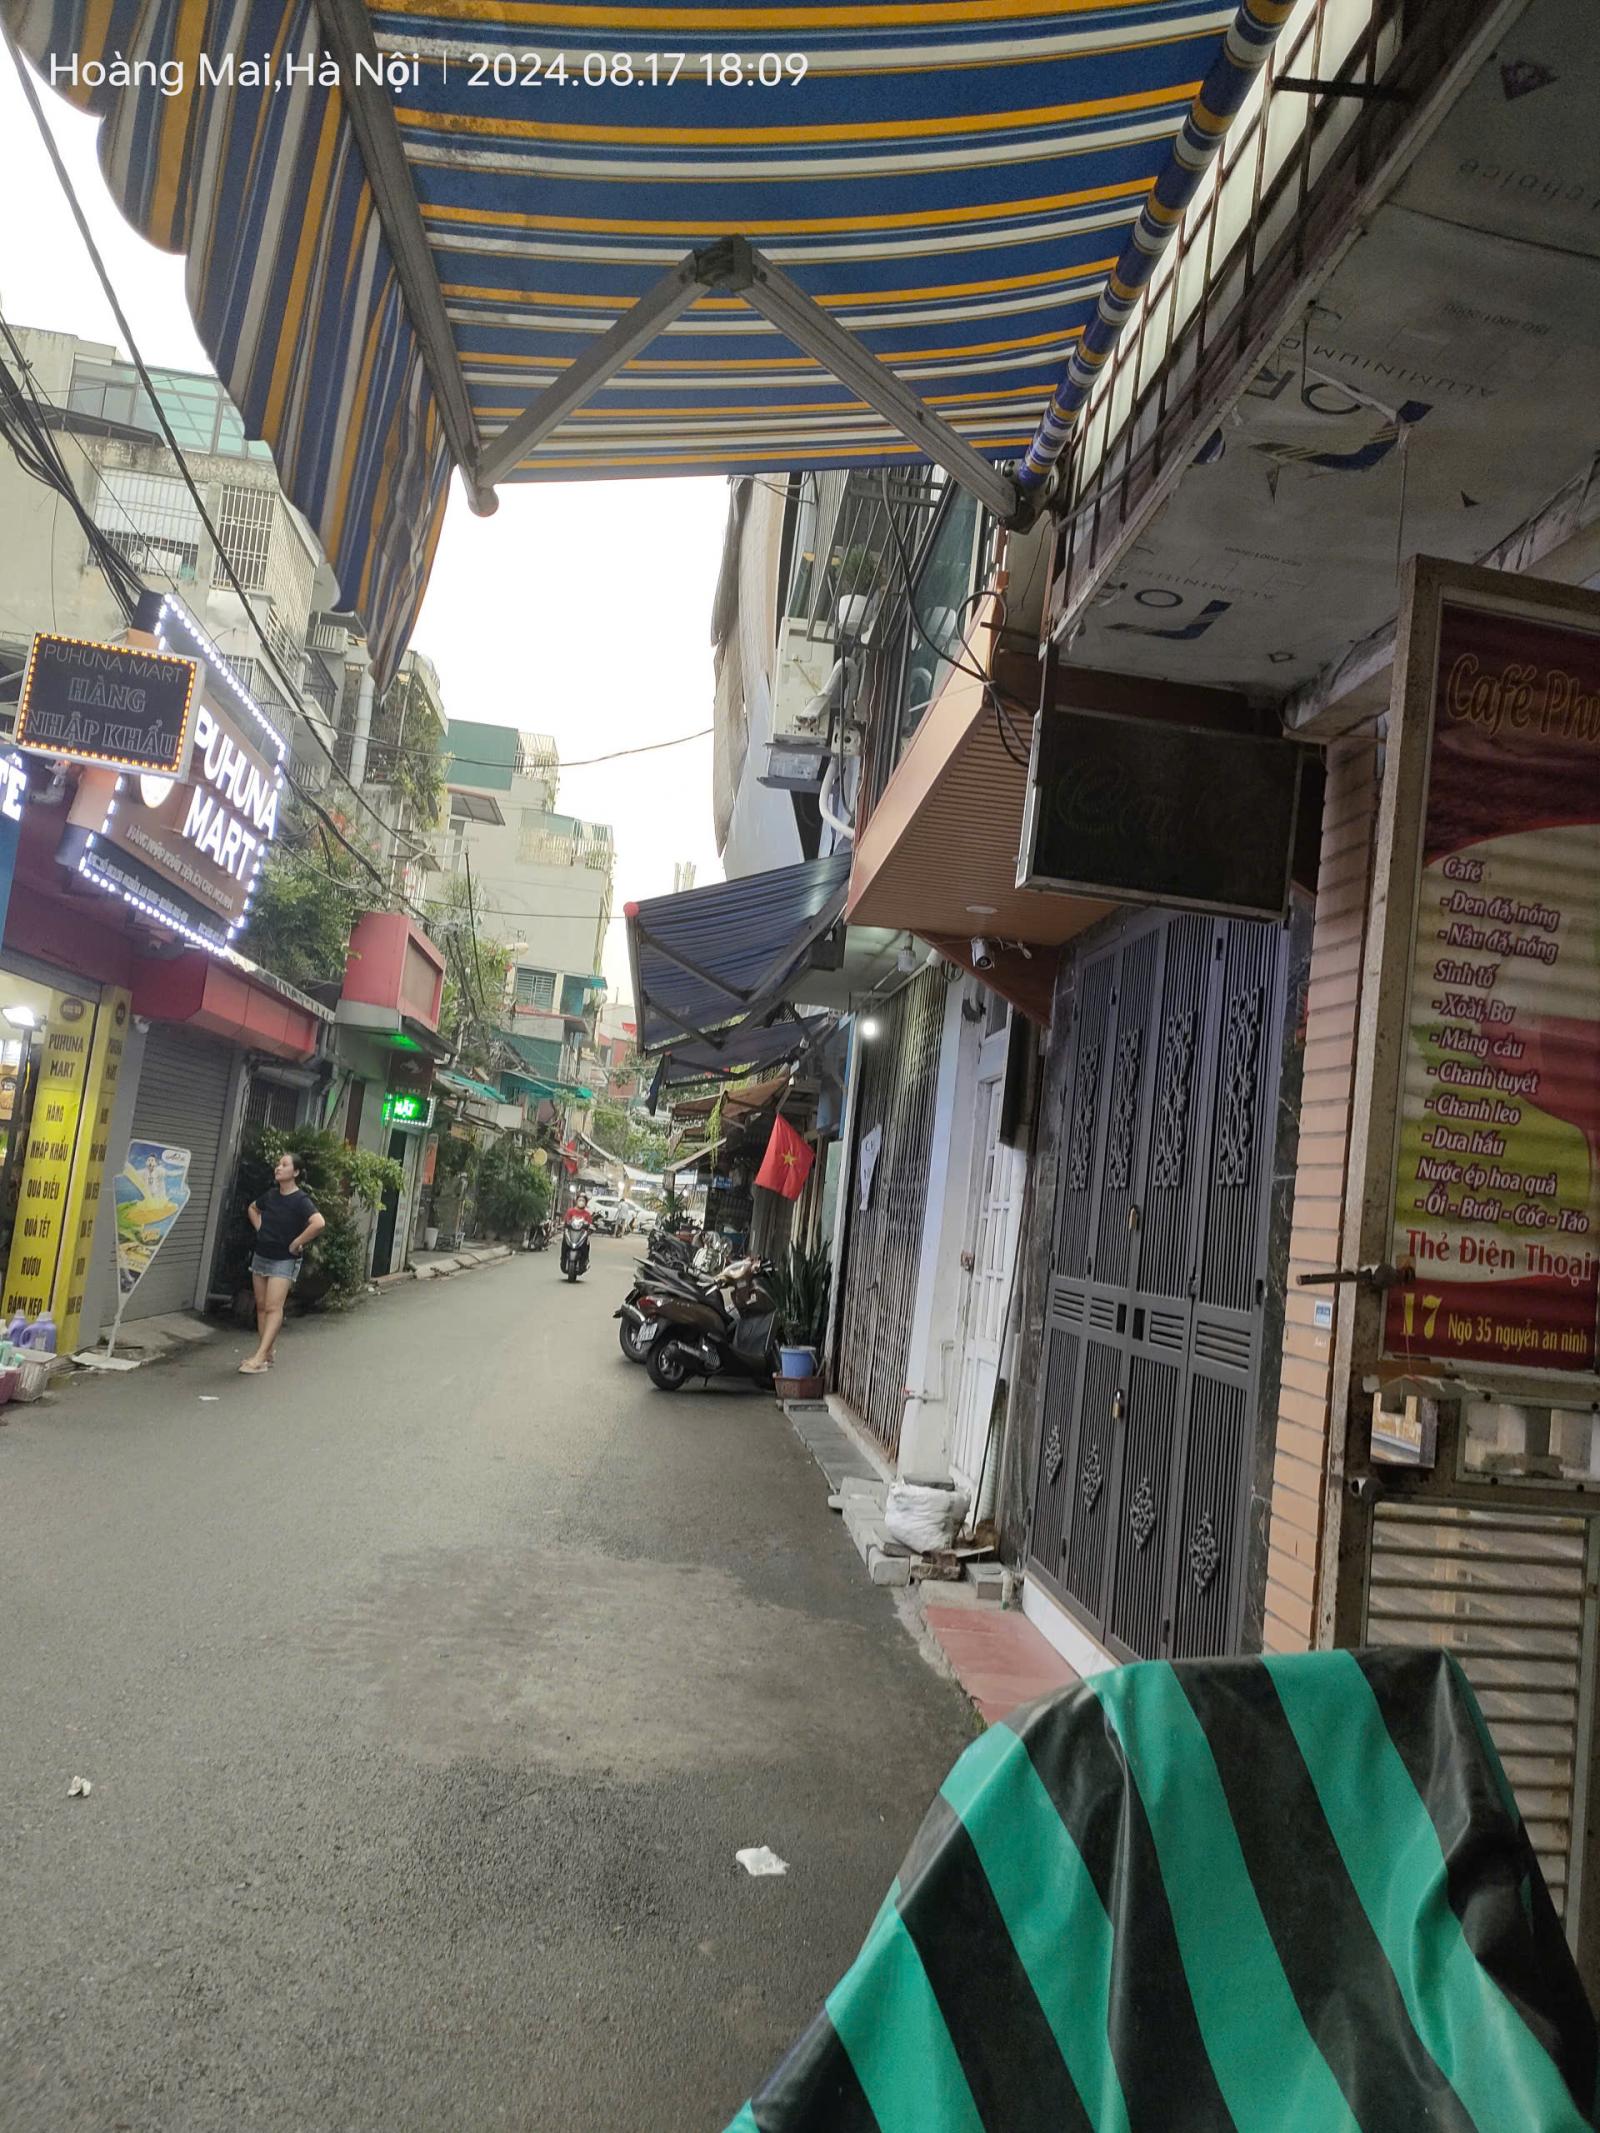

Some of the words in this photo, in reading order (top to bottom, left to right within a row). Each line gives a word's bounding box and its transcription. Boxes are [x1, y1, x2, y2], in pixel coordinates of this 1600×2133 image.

[43, 644, 123, 673] PUHUNA
[129, 659, 183, 685] MART
[68, 674, 148, 713] HÀNG
[1446, 652, 1538, 737] Café
[25, 710, 99, 747] NHẬP
[102, 719, 179, 761] KHẨU
[182, 785, 256, 881] MART
[1443, 855, 1483, 883] Café
[1452, 892, 1486, 918] Đen
[1515, 901, 1560, 934] nóng
[1447, 924, 1484, 949] Nâu
[1513, 932, 1559, 965] nóng
[1434, 960, 1473, 985] Sinh
[1475, 962, 1497, 988] tố
[1489, 999, 1515, 1025] Bơ
[48, 1034, 84, 1053] PUHUNA
[1440, 1026, 1490, 1059] Mãng
[1492, 1035, 1525, 1060] cầu
[49, 1059, 76, 1079] MART
[1438, 1060, 1495, 1089] Chanh
[1496, 1069, 1540, 1096] tuyết
[1436, 1093, 1494, 1121] Chanh
[1493, 1097, 1522, 1124] leo
[1433, 1127, 1469, 1154] Dưa
[1470, 1126, 1506, 1158] hấu
[1416, 1157, 1462, 1186] Nước
[1463, 1161, 1488, 1192] ép
[1489, 1168, 1522, 1195] hoa
[1524, 1167, 1558, 1201] quả
[1460, 1194, 1503, 1224] Bưởi
[1514, 1200, 1547, 1229] Cóc
[1557, 1205, 1590, 1234] Táo
[1404, 1228, 1450, 1262] Thẻ
[1458, 1234, 1516, 1276] Điện
[1524, 1242, 1593, 1288] Thoại
[1400, 1291, 1443, 1340] 17
[1447, 1313, 1474, 1347] Ngõ
[1475, 1316, 1492, 1344] 35
[1494, 1318, 1540, 1353] nguyễn
[1541, 1328, 1559, 1352] an
[1560, 1327, 1588, 1355] ninh
